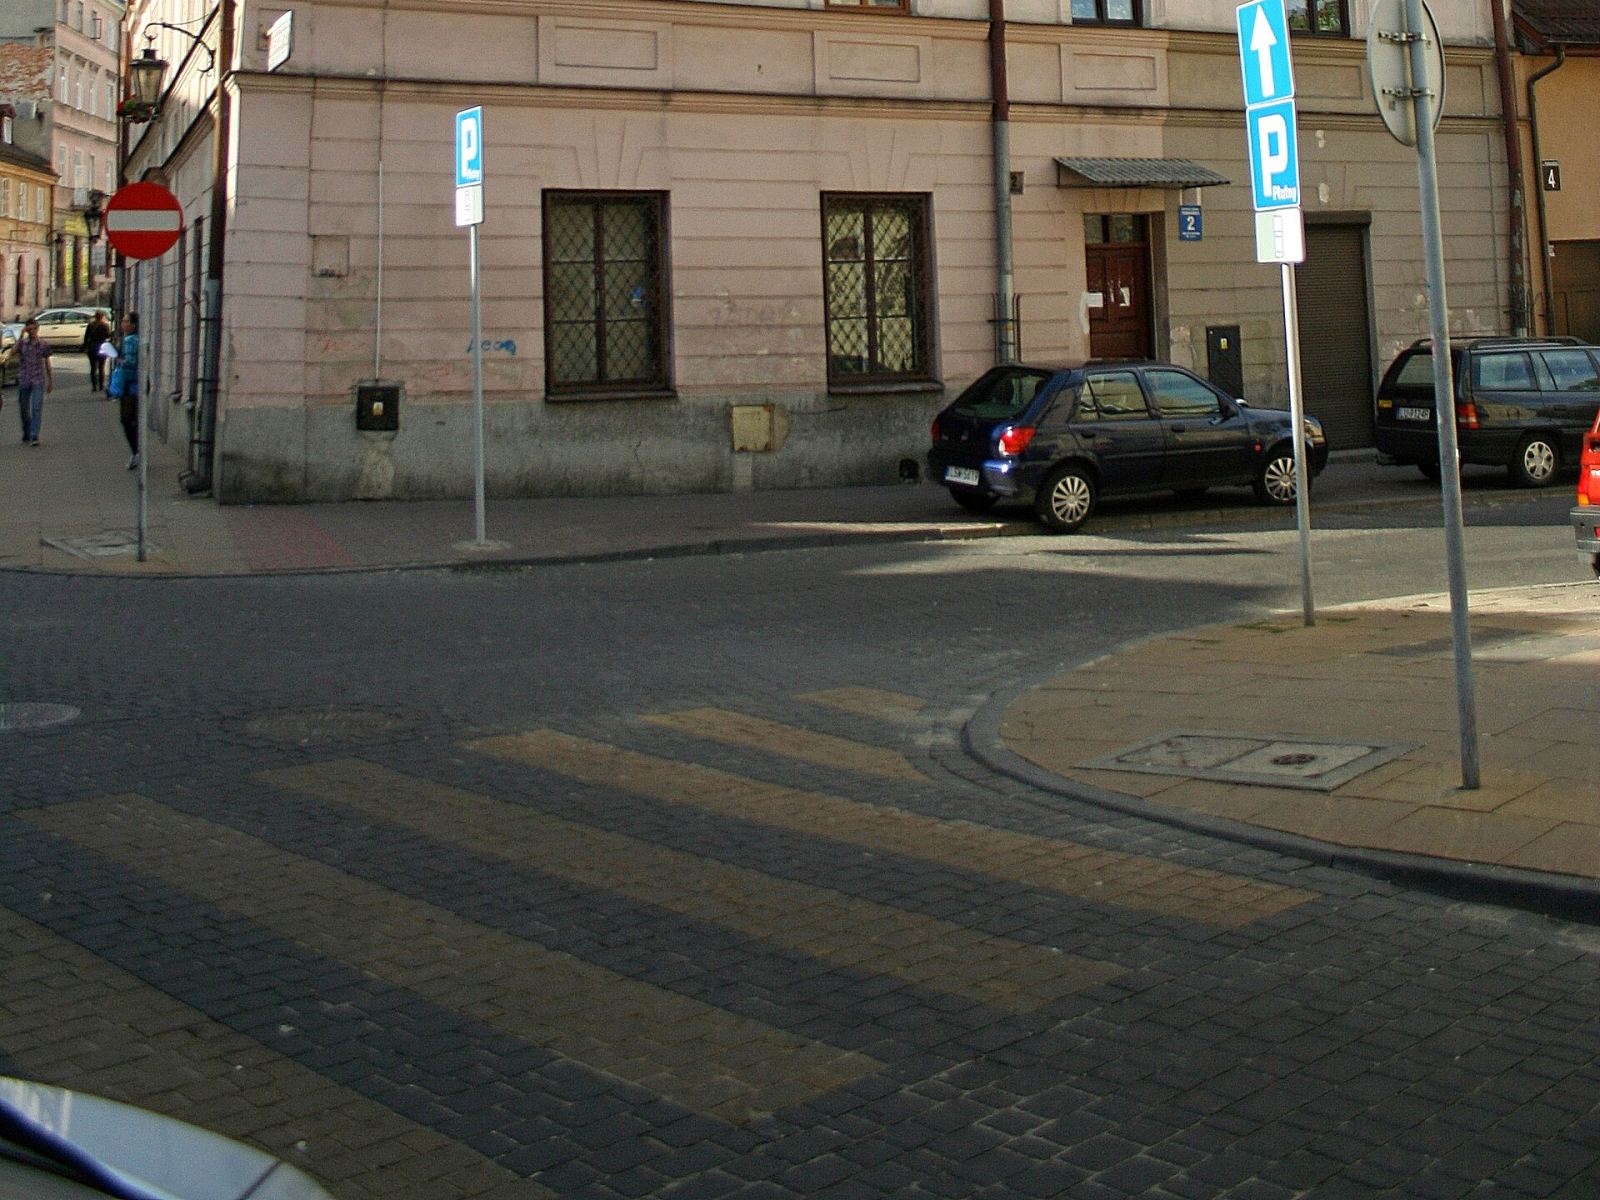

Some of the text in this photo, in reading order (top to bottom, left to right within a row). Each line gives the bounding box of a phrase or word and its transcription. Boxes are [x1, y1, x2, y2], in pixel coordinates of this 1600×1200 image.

[461, 118, 477, 178] P
[1258, 114, 1288, 197] P
[1548, 169, 1555, 188] 4
[1187, 216, 1195, 230] 2
